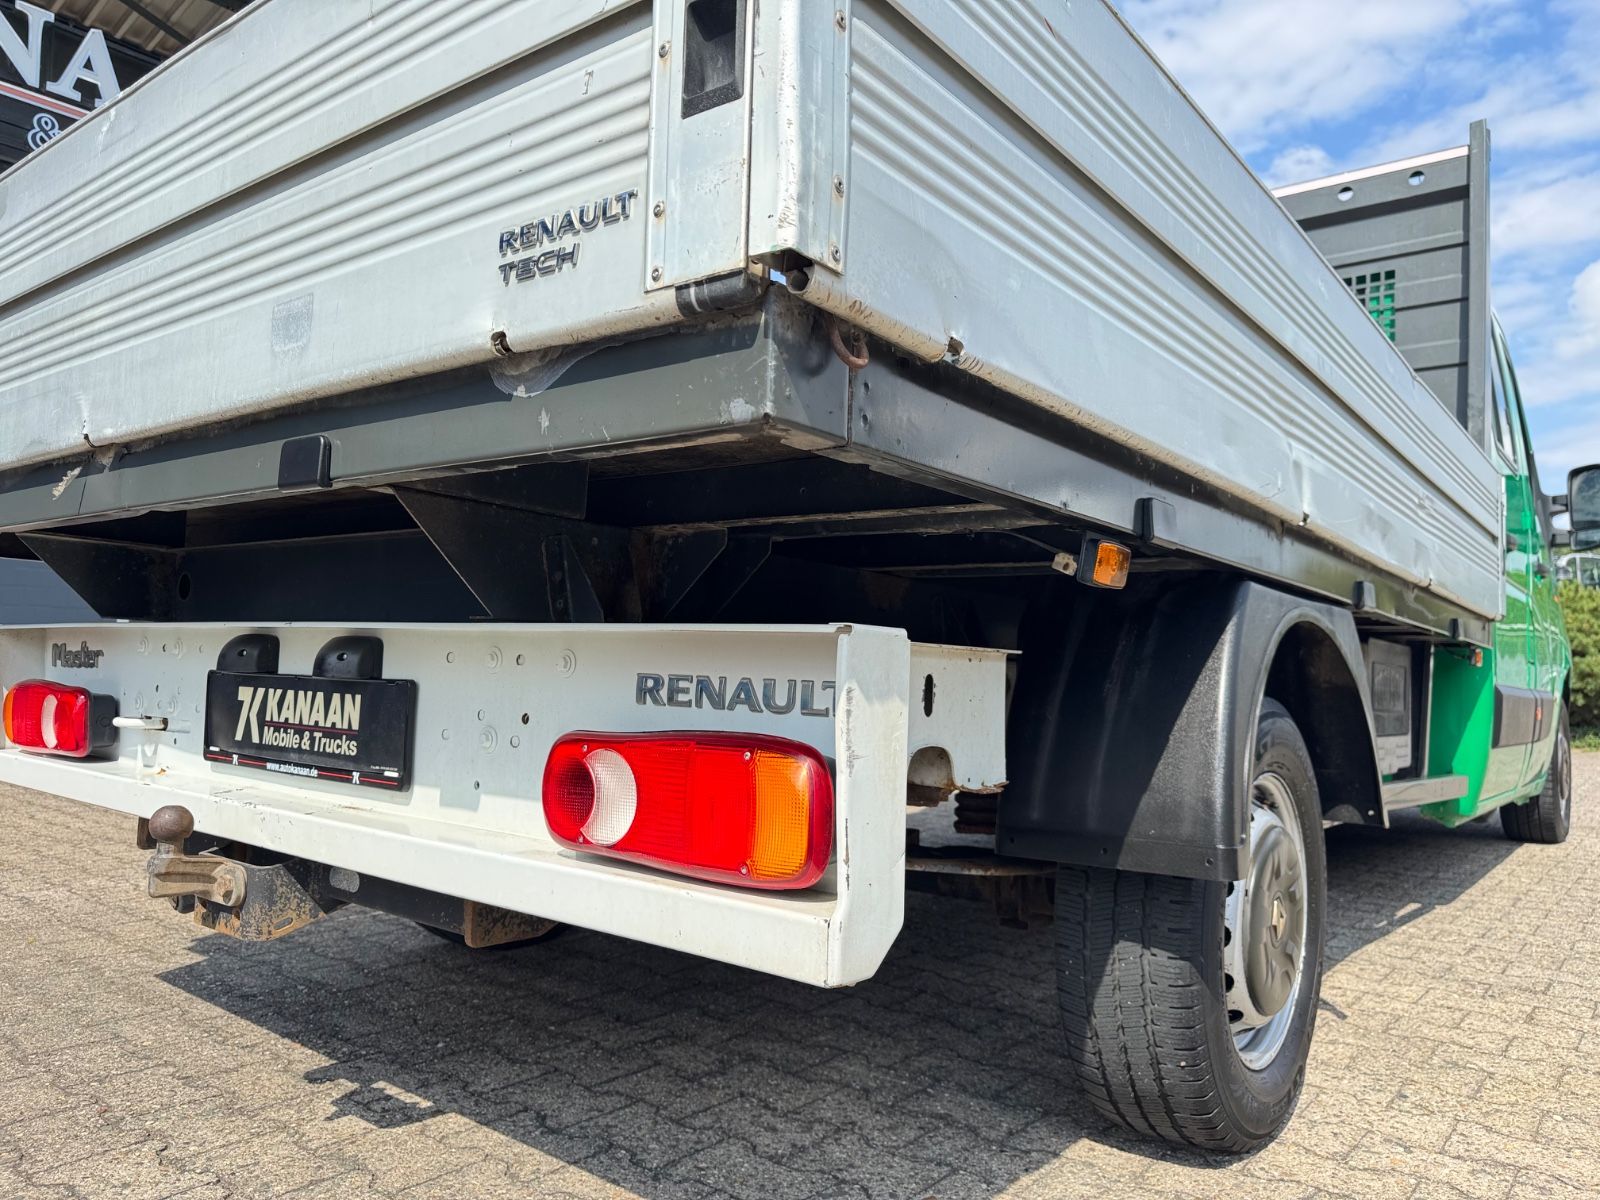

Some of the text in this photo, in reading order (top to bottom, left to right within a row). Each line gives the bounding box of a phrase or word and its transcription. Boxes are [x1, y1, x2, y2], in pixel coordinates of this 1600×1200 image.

[499, 188, 638, 258] RENAULT
[498, 243, 580, 287] TECH
[52, 641, 104, 668] Master
[265, 688, 361, 730] KANAAN
[262, 725, 358, 756] Mobile & Trucks
